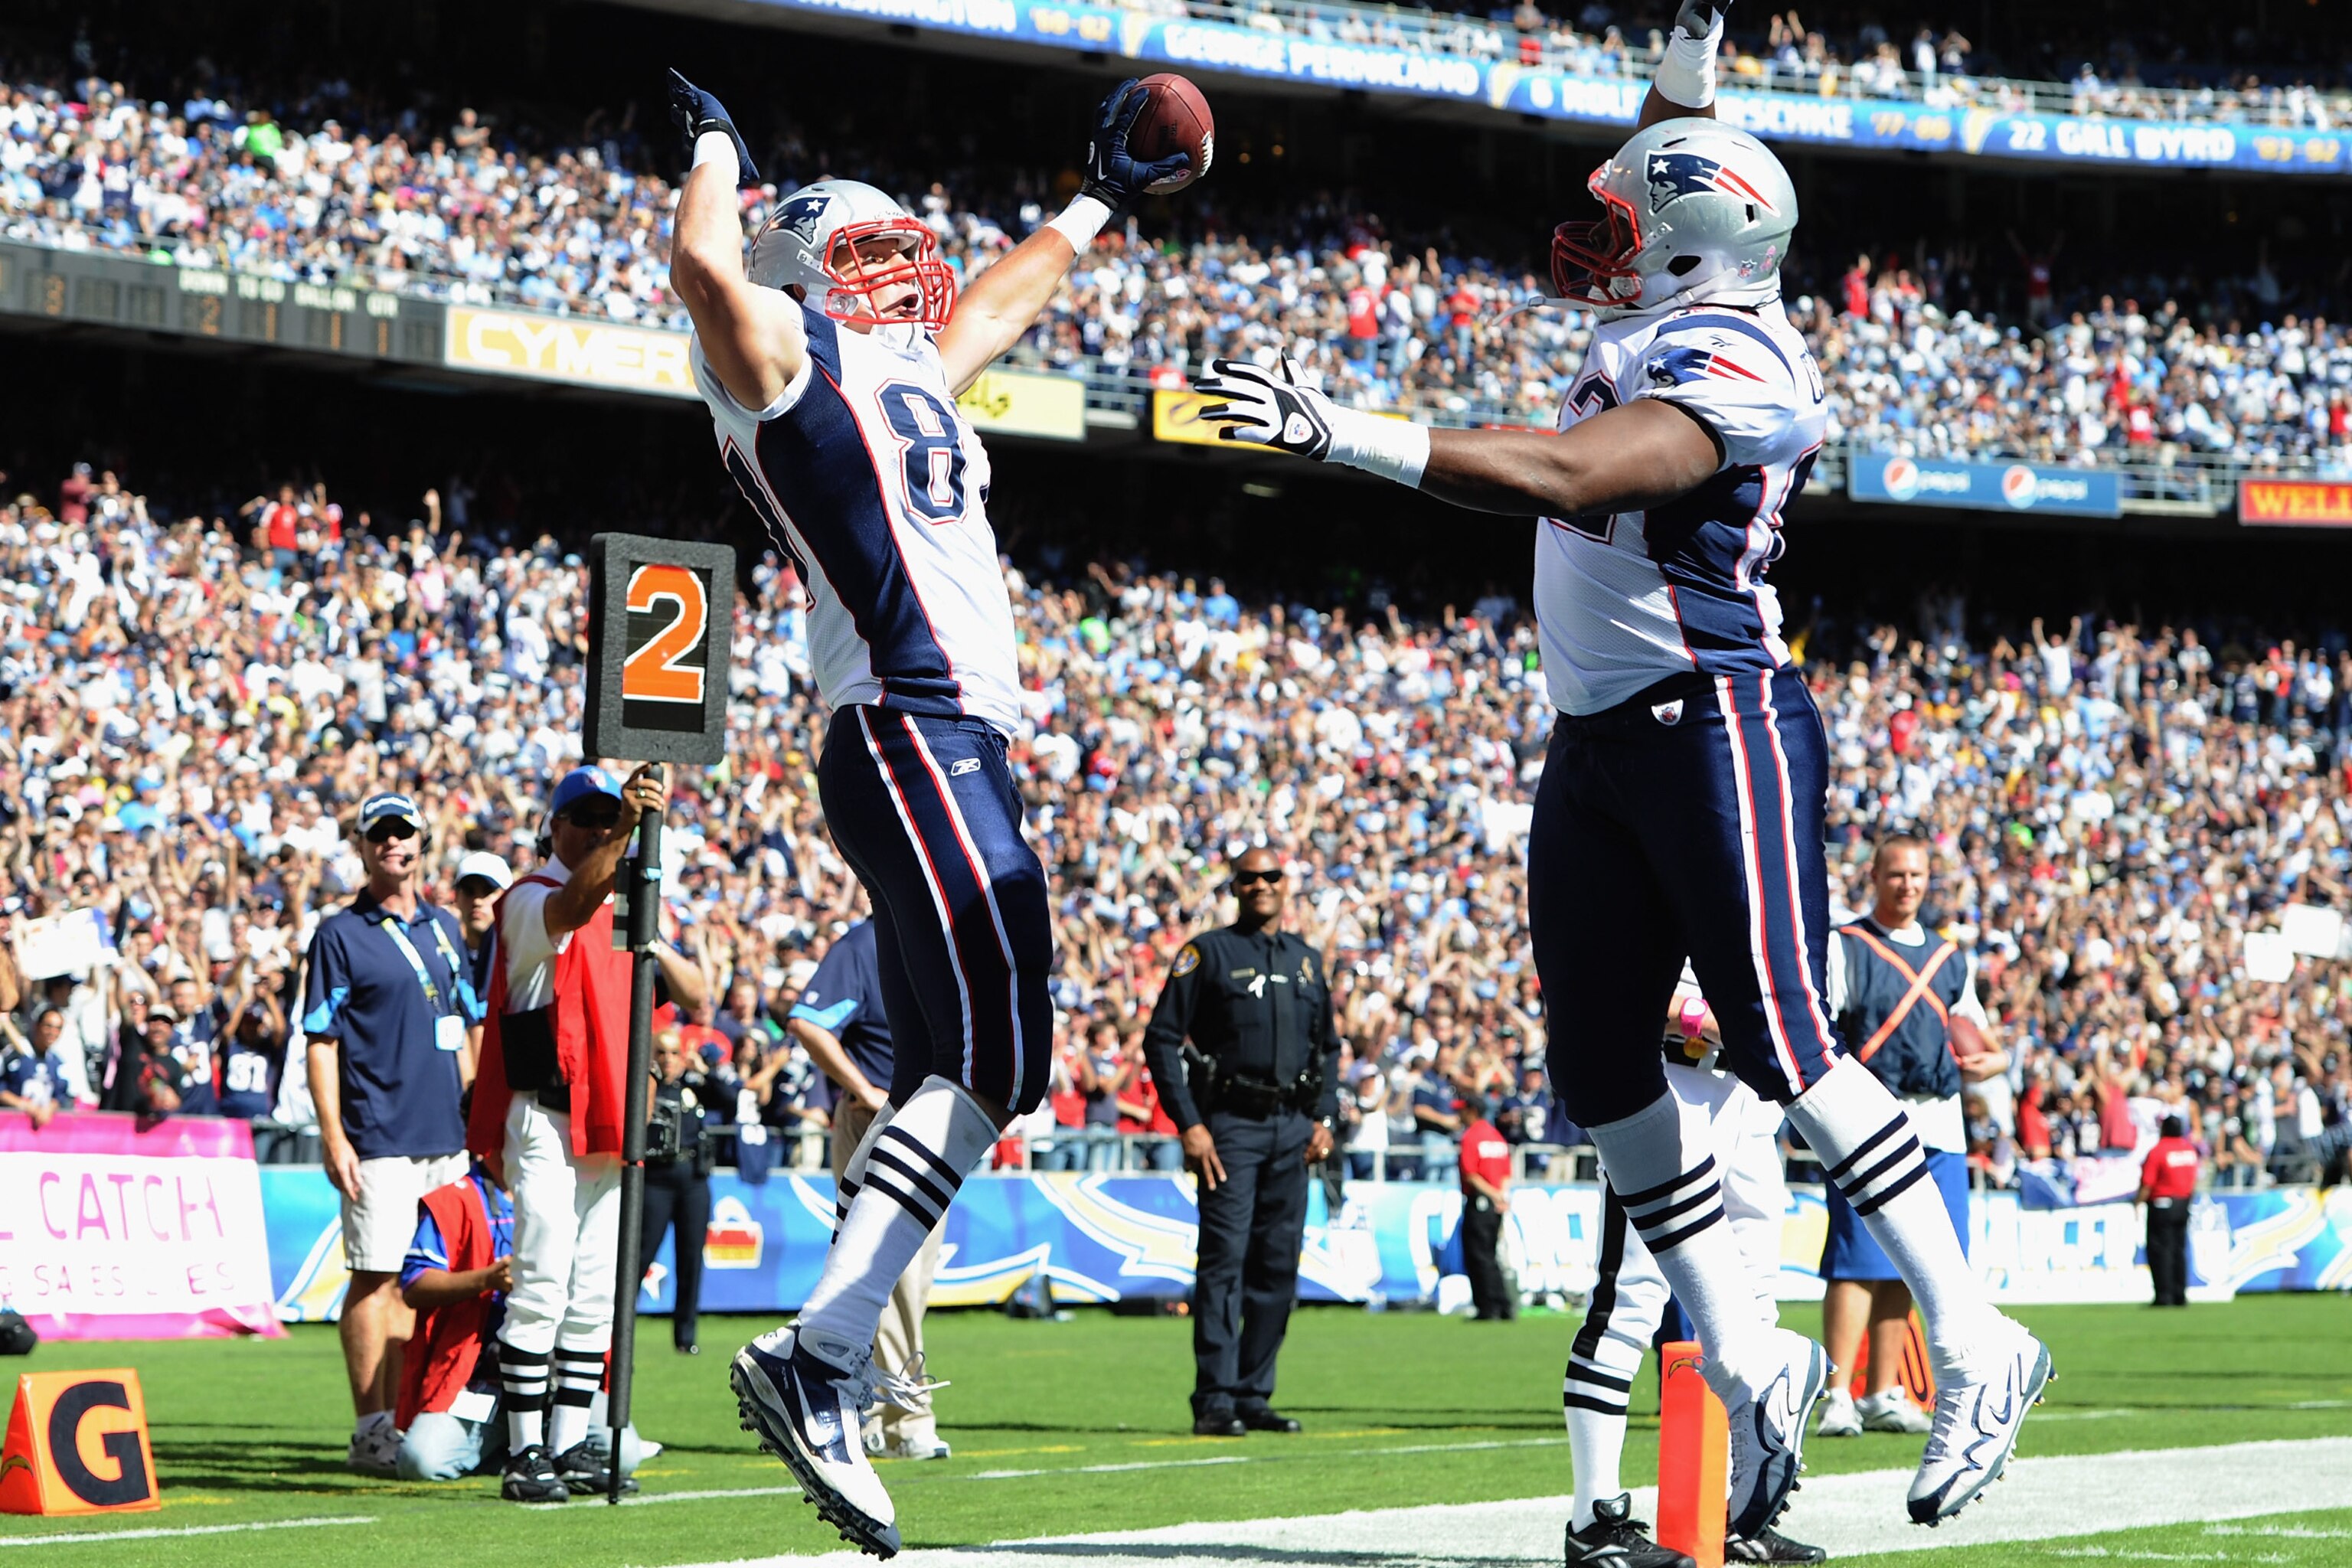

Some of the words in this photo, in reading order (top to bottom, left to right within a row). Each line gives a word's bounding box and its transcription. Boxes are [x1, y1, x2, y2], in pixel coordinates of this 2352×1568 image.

[1164, 24, 1288, 72] GEORGE
[2009, 121, 2047, 151] 22
[2134, 127, 2236, 162] BYRD
[467, 314, 688, 388] CYMER
[622, 564, 707, 704] 2
[40, 1171, 224, 1241] CATCH
[34, 1265, 125, 1296] SAES
[48, 1380, 151, 1507] G
